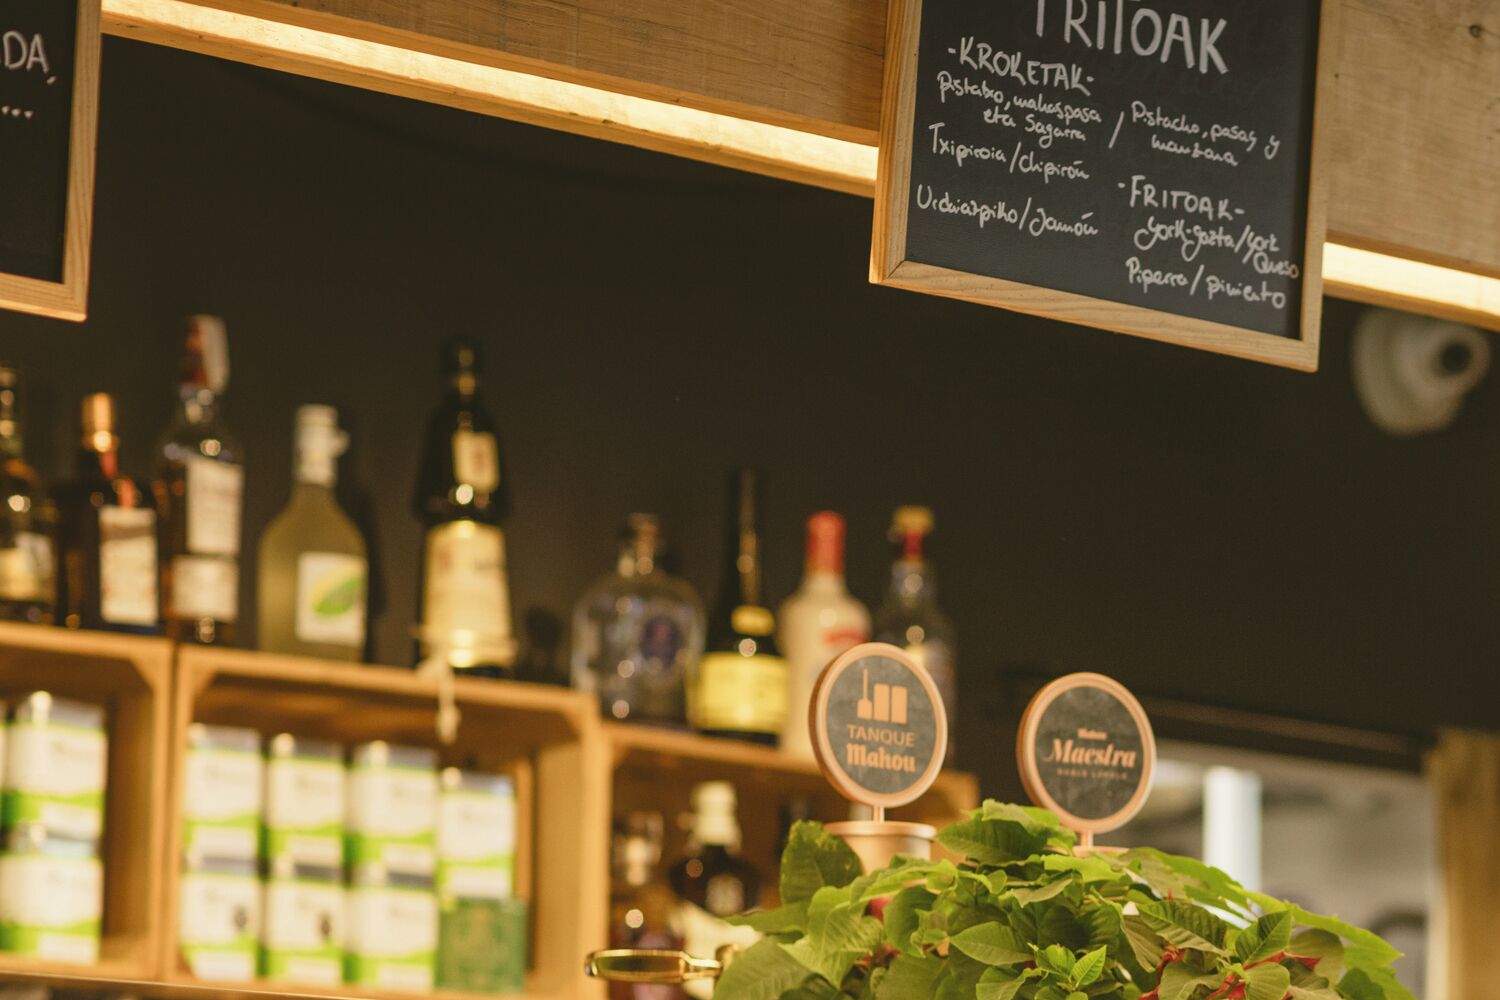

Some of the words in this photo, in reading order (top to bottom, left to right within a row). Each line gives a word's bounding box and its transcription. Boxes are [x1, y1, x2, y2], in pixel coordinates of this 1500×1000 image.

[983, 105, 1017, 128] eta
[847, 723, 916, 749] TANQUE
[846, 742, 917, 773] Mahou
[1043, 738, 1138, 769] Maestra
